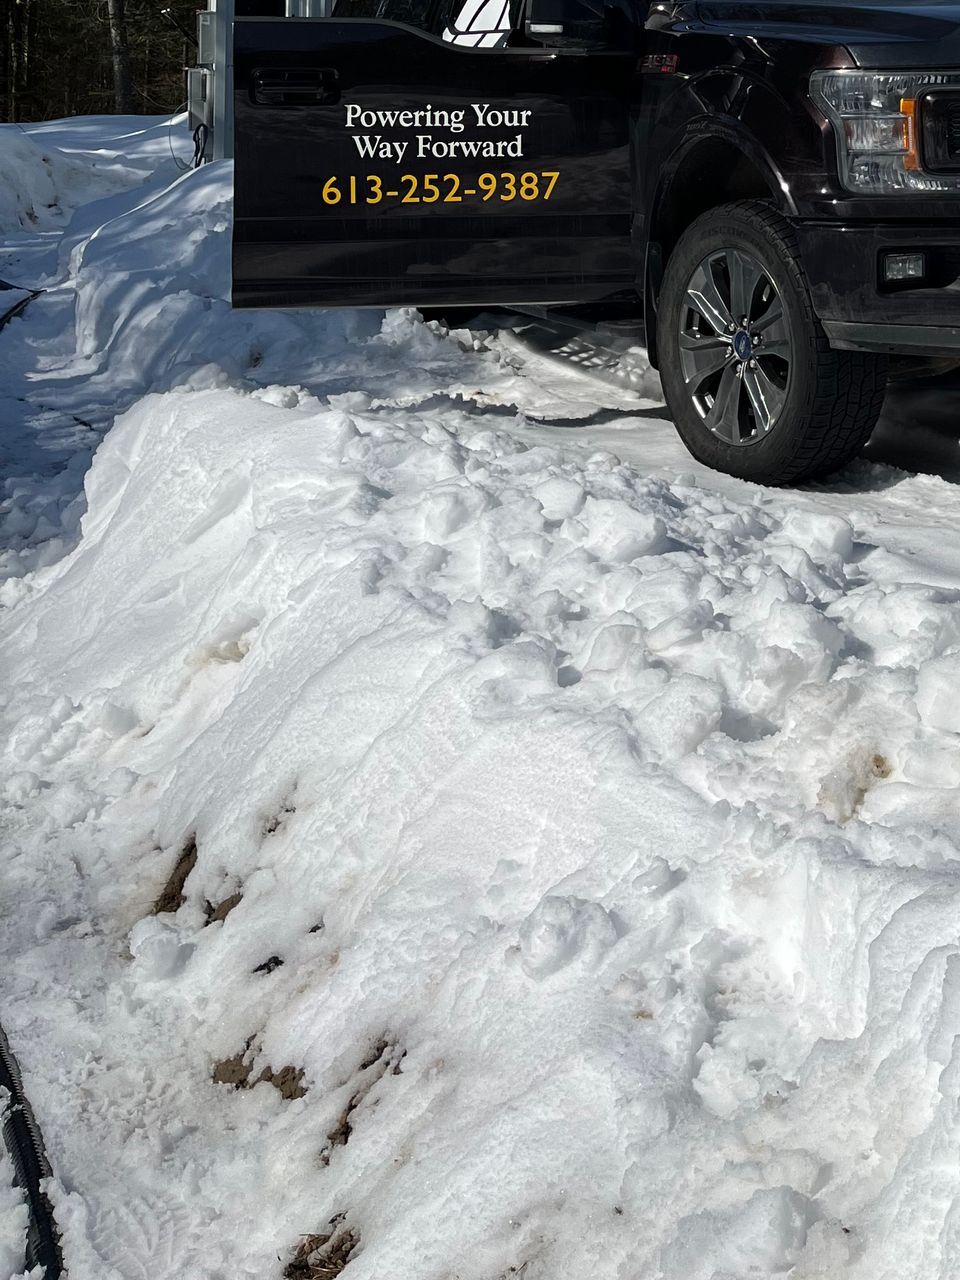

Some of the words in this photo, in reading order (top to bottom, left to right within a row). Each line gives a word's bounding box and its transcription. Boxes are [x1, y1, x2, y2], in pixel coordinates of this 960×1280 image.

[344, 104, 465, 133] Powering
[471, 103, 532, 127] Your
[352, 135, 409, 164] Way
[416, 134, 524, 159] Forward
[322, 171, 561, 205] 613-252-9387
